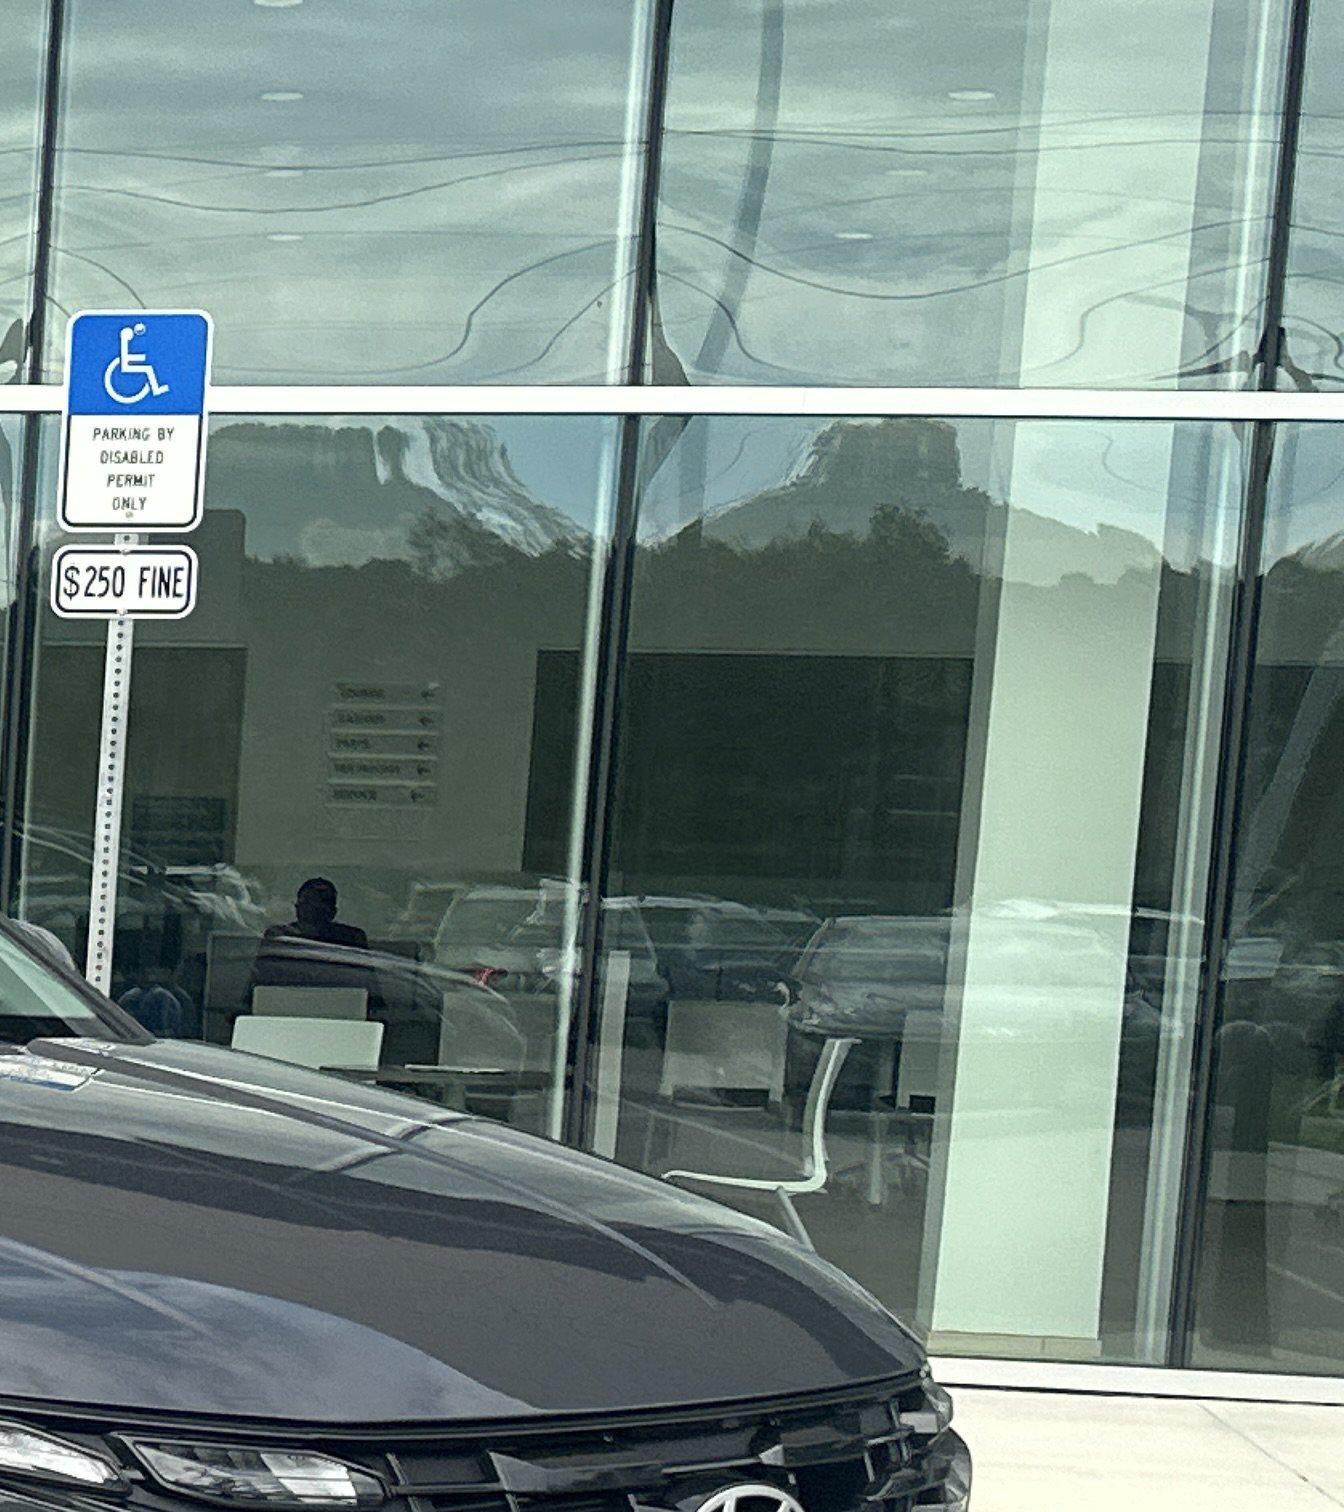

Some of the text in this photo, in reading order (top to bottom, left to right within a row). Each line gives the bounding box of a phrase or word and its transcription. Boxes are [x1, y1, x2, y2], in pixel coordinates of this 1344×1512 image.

[92, 426, 175, 442] PARKING BY
[100, 450, 164, 465] DISABLED
[106, 474, 156, 488] PERMIT
[112, 496, 148, 511] ONLY
[63, 563, 185, 601] $250 FINE
